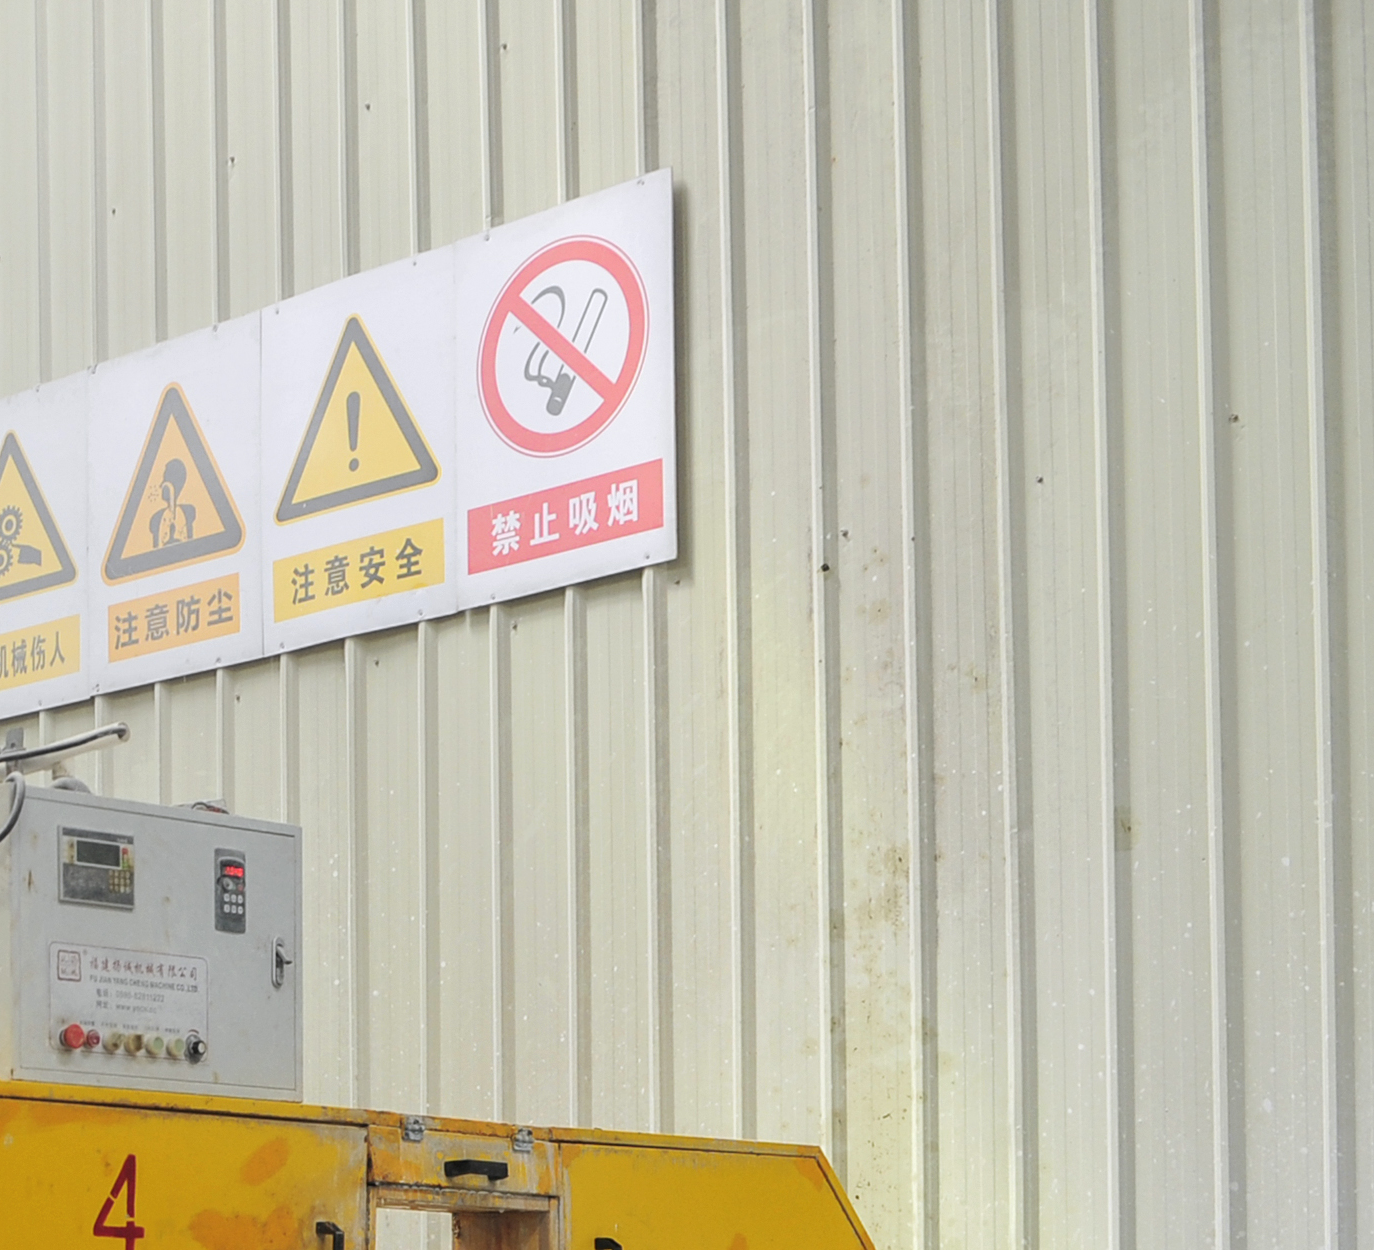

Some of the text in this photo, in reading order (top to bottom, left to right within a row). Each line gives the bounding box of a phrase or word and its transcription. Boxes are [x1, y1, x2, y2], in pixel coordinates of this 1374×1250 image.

[491, 479, 639, 557] 禁止吸烟
[290, 538, 424, 605] 注意安全
[114, 588, 234, 650] 注意防尘
